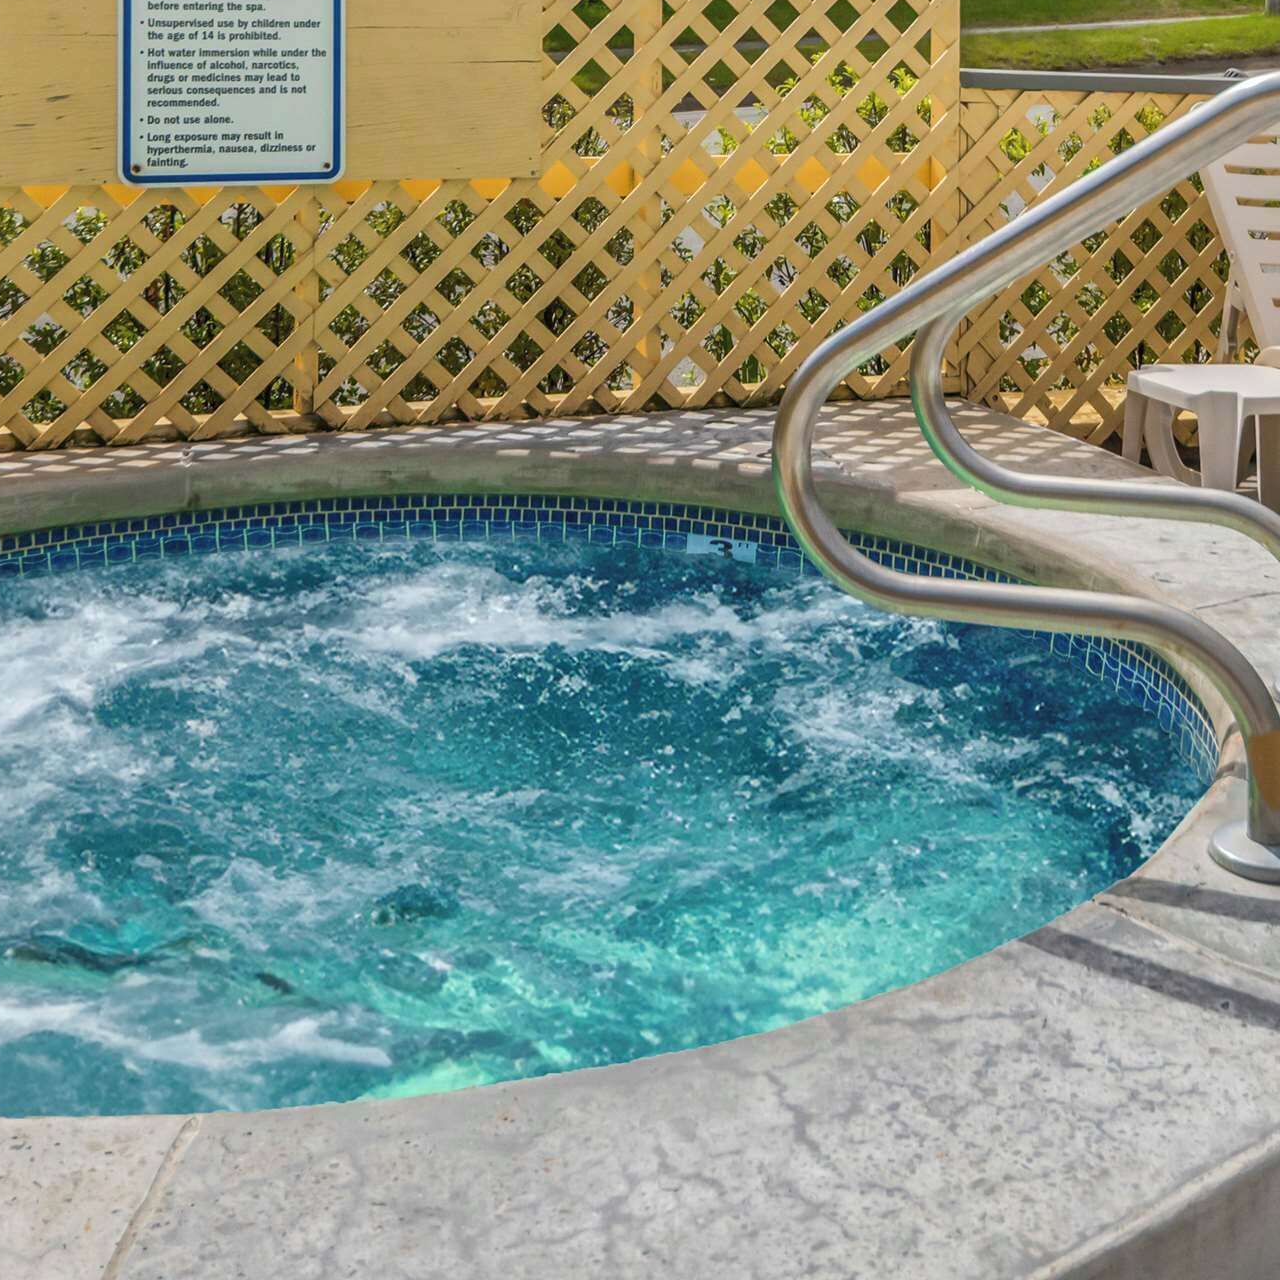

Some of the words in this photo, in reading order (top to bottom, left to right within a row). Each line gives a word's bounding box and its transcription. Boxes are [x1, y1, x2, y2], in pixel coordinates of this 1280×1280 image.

[147, 1, 180, 11] before
[182, 1, 224, 12] entering
[227, 1, 243, 11] the
[148, 18, 214, 29] Unsupervised
[217, 20, 234, 28] use
[237, 18, 248, 29] by
[251, 19, 290, 29] children
[293, 19, 321, 29] under
[147, 30, 164, 40] the
[167, 32, 185, 41] age
[188, 30, 199, 40] of
[201, 30, 214, 40] 14
[217, 31, 226, 41] is
[147, 48, 165, 58] Hot
[168, 48, 196, 58] water
[199, 48, 250, 58] immersion
[252, 48, 278, 58] while
[281, 48, 309, 58] under
[311, 48, 327, 58] the
[147, 60, 193, 70] influence
[196, 60, 207, 70] of
[147, 72, 175, 83] drugs
[178, 74, 189, 82] or
[191, 72, 241, 82] medicines
[244, 74, 264, 83] may
[267, 72, 287, 82] lead
[290, 72, 300, 82] to
[147, 85, 183, 95] serious
[186, 87, 256, 96] consequences
[259, 84, 277, 94] and
[280, 84, 288, 94] is
[291, 84, 307, 94] not
[147, 114, 161, 124] Do
[164, 114, 180, 124] not
[183, 116, 200, 124] use
[147, 131, 171, 142] Long
[174, 133, 218, 142] exposure
[221, 133, 241, 142] may
[244, 130, 272, 140] result
[274, 130, 284, 140] in
[260, 142, 303, 152] dizziness
[306, 144, 316, 152] or
